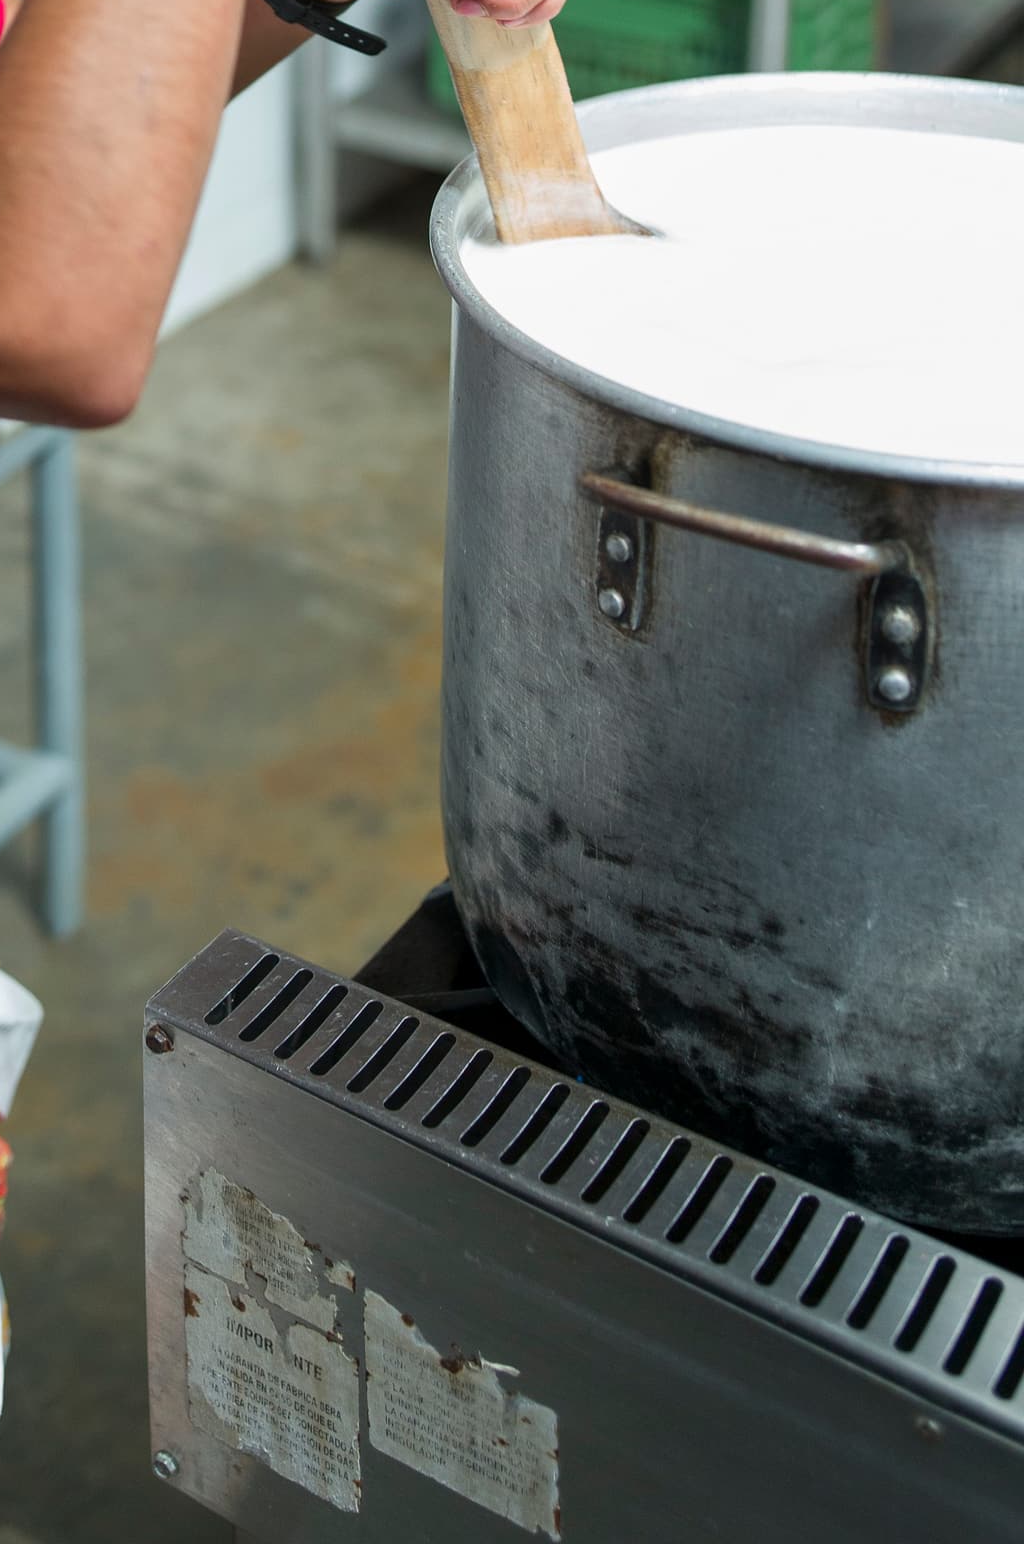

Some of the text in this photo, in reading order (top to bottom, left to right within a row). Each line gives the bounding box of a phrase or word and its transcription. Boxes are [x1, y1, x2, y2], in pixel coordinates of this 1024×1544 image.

[226, 1319, 323, 1381] IMPORNTE
[256, 1379, 266, 1393] EN
[294, 1400, 304, 1415] DE
[307, 1407, 325, 1427] QUE
[327, 1419, 336, 1433] EL
[281, 1379, 316, 1407] FABRICA
[320, 1400, 341, 1421] SERA
[298, 1416, 346, 1452] CONECTADO
[349, 1444, 354, 1456] A
[323, 1443, 333, 1458] DE
